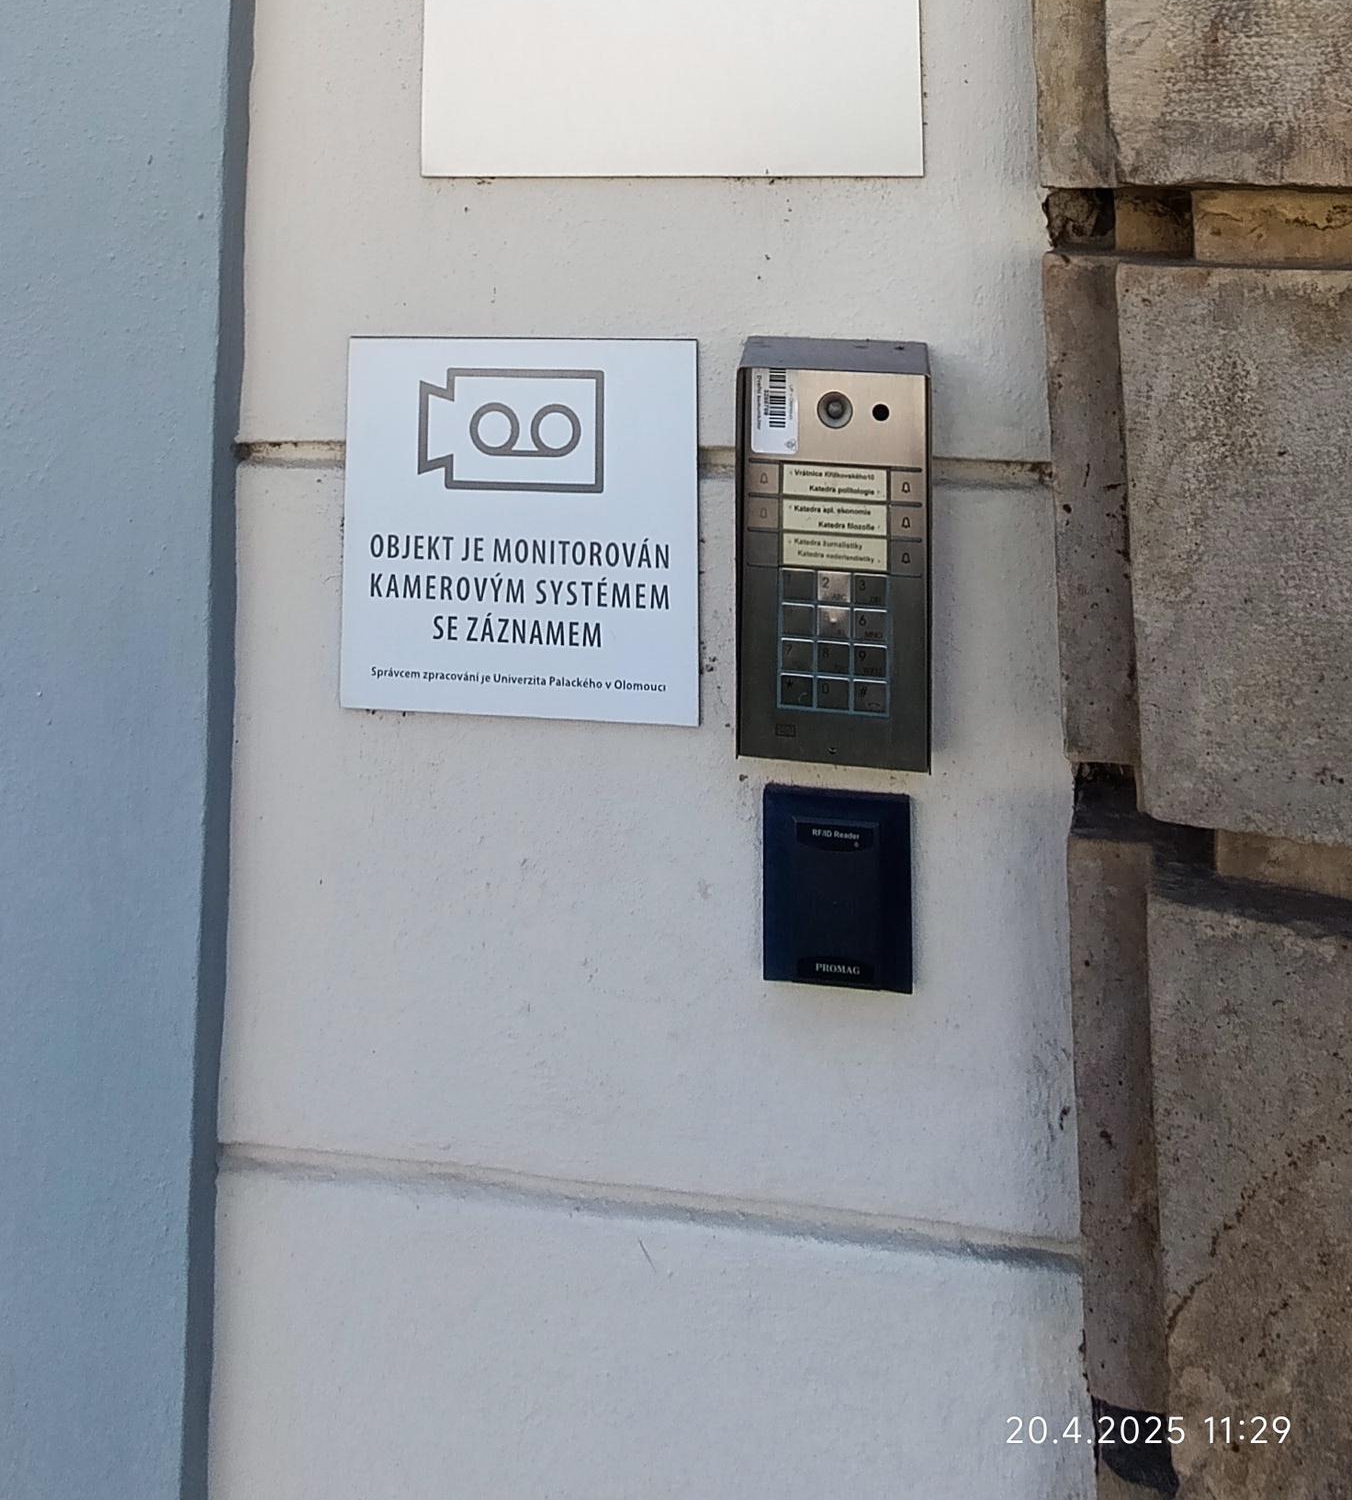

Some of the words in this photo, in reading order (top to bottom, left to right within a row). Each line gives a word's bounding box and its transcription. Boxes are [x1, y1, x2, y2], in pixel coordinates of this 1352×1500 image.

[809, 485, 836, 494] Katedra
[794, 504, 820, 515] Katedra
[818, 521, 845, 531] Katedra
[794, 537, 820, 548] Katedra
[370, 534, 454, 562] OBJEKT
[461, 537, 484, 563] JE
[493, 538, 670, 569] MONITOROVÁN
[797, 549, 824, 559] Katedra
[822, 577, 829, 589] 2
[859, 579, 866, 591] 3
[370, 572, 525, 604] KAMEROVÝM
[535, 577, 670, 610] SYSTÉMEM
[859, 615, 867, 626] 6
[432, 615, 458, 641] SE
[466, 613, 602, 648] ZÁZNAMEM
[859, 650, 867, 661] 9
[371, 666, 420, 683] Správcem
[422, 670, 480, 686] zpracování
[480, 672, 491, 685] je
[493, 673, 547, 687] Univerzita
[549, 676, 602, 690] Palackého
[605, 681, 612, 689] v
[614, 679, 667, 692] Olomouci
[834, 830, 860, 840] Reader
[815, 963, 860, 975] PROMAG
